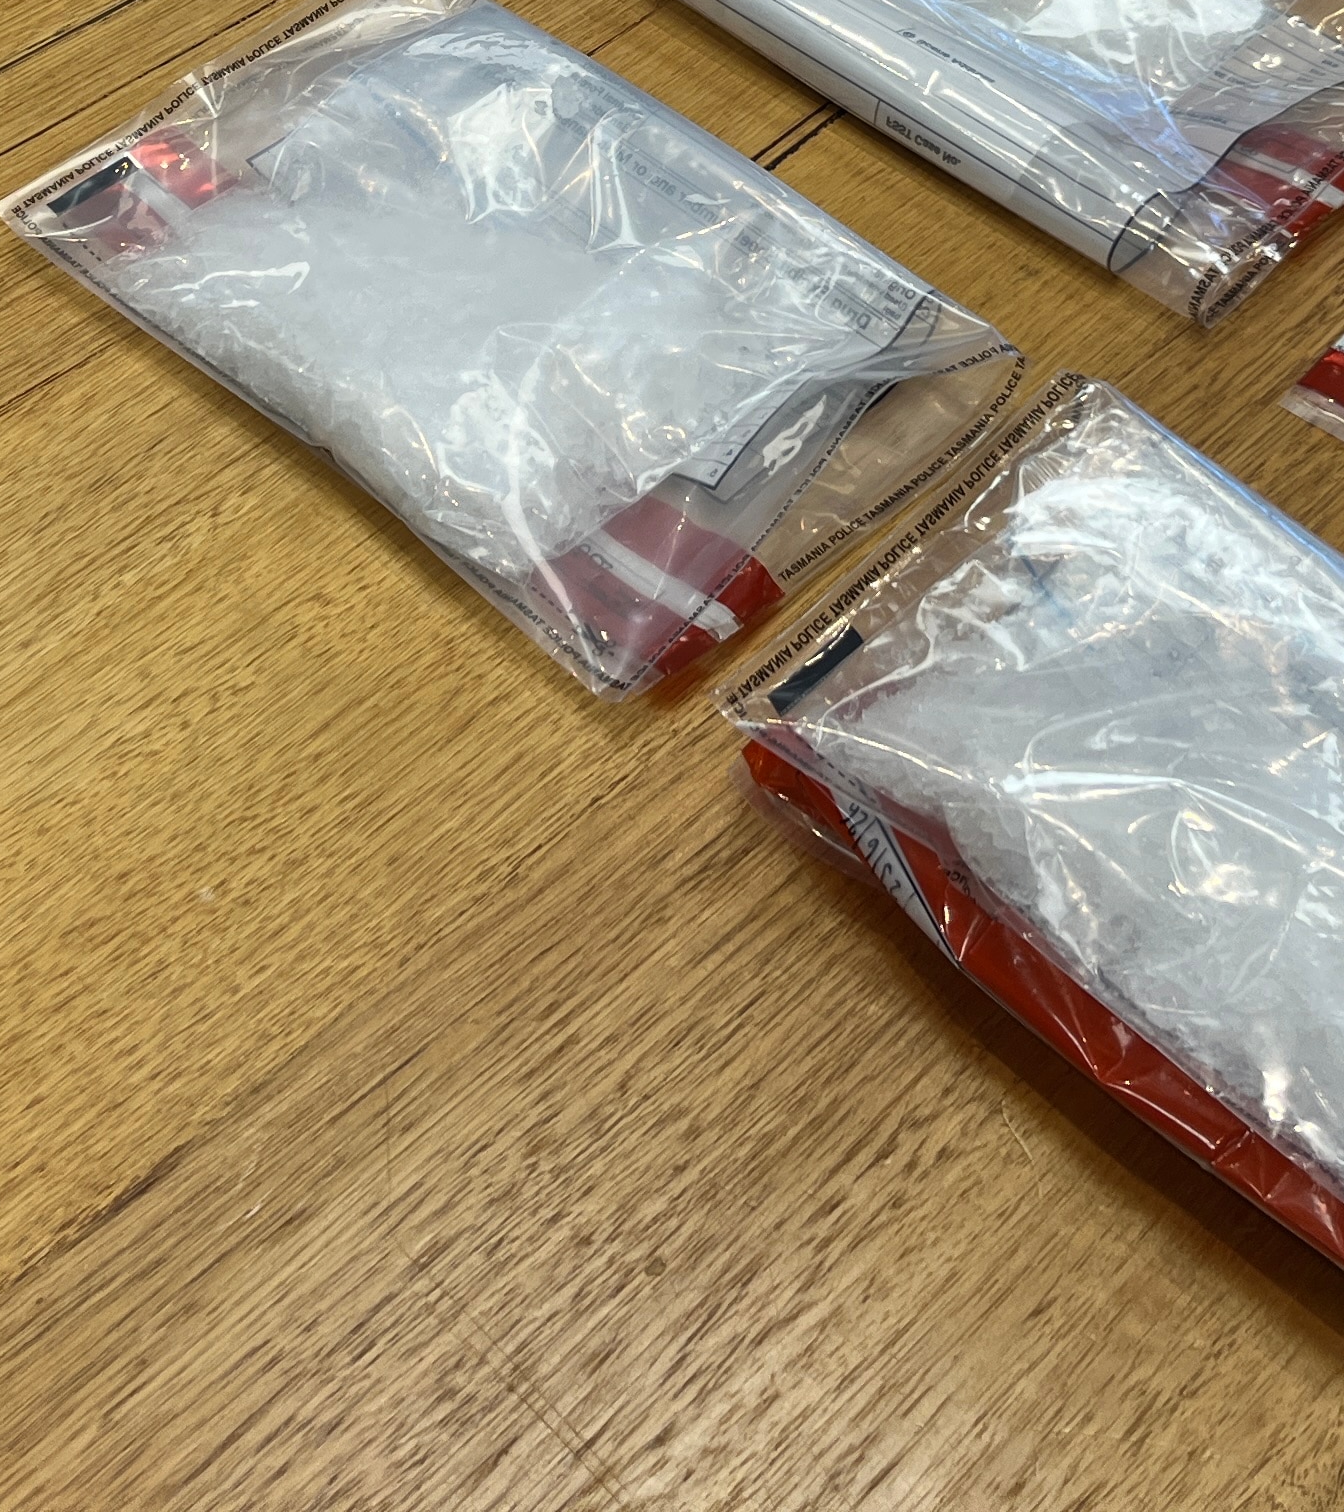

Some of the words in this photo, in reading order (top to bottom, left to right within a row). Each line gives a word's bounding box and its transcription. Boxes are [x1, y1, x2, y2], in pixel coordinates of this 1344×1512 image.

[778, 541, 831, 582] TASMANIA
[828, 518, 865, 548] POLICE
[864, 481, 914, 525] TASMANIA
[911, 457, 947, 490] POLICE
[945, 414, 995, 463] TASMANIA
[991, 377, 1023, 418] POLICE
